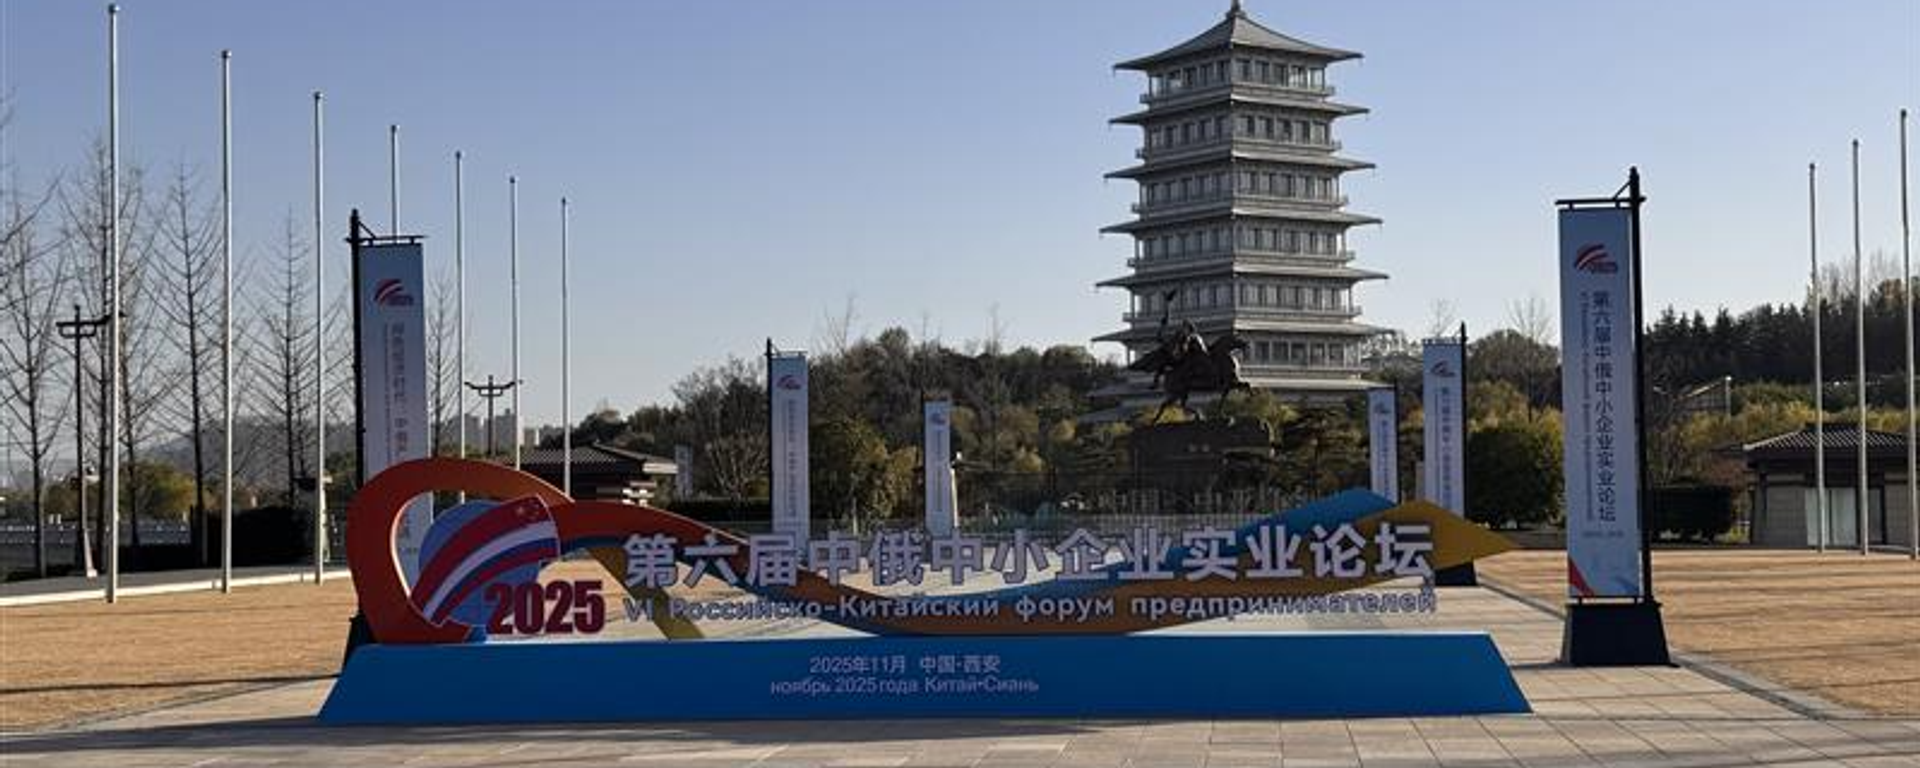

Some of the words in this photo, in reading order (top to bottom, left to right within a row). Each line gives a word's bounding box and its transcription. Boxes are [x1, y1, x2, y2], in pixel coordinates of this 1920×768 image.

[624, 522, 1436, 590] 第六届中俄中小企业实业论坛
[485, 579, 606, 635] 2025
[624, 597, 654, 622] VI
[669, 595, 1001, 621] Российско-Китайский
[1014, 594, 1115, 623] форум
[1130, 588, 1437, 622] предпринимателей
[809, 655, 905, 674] 2025年11月
[770, 677, 831, 696] ноябрь
[834, 677, 877, 693] 2025
[879, 680, 919, 695] года
